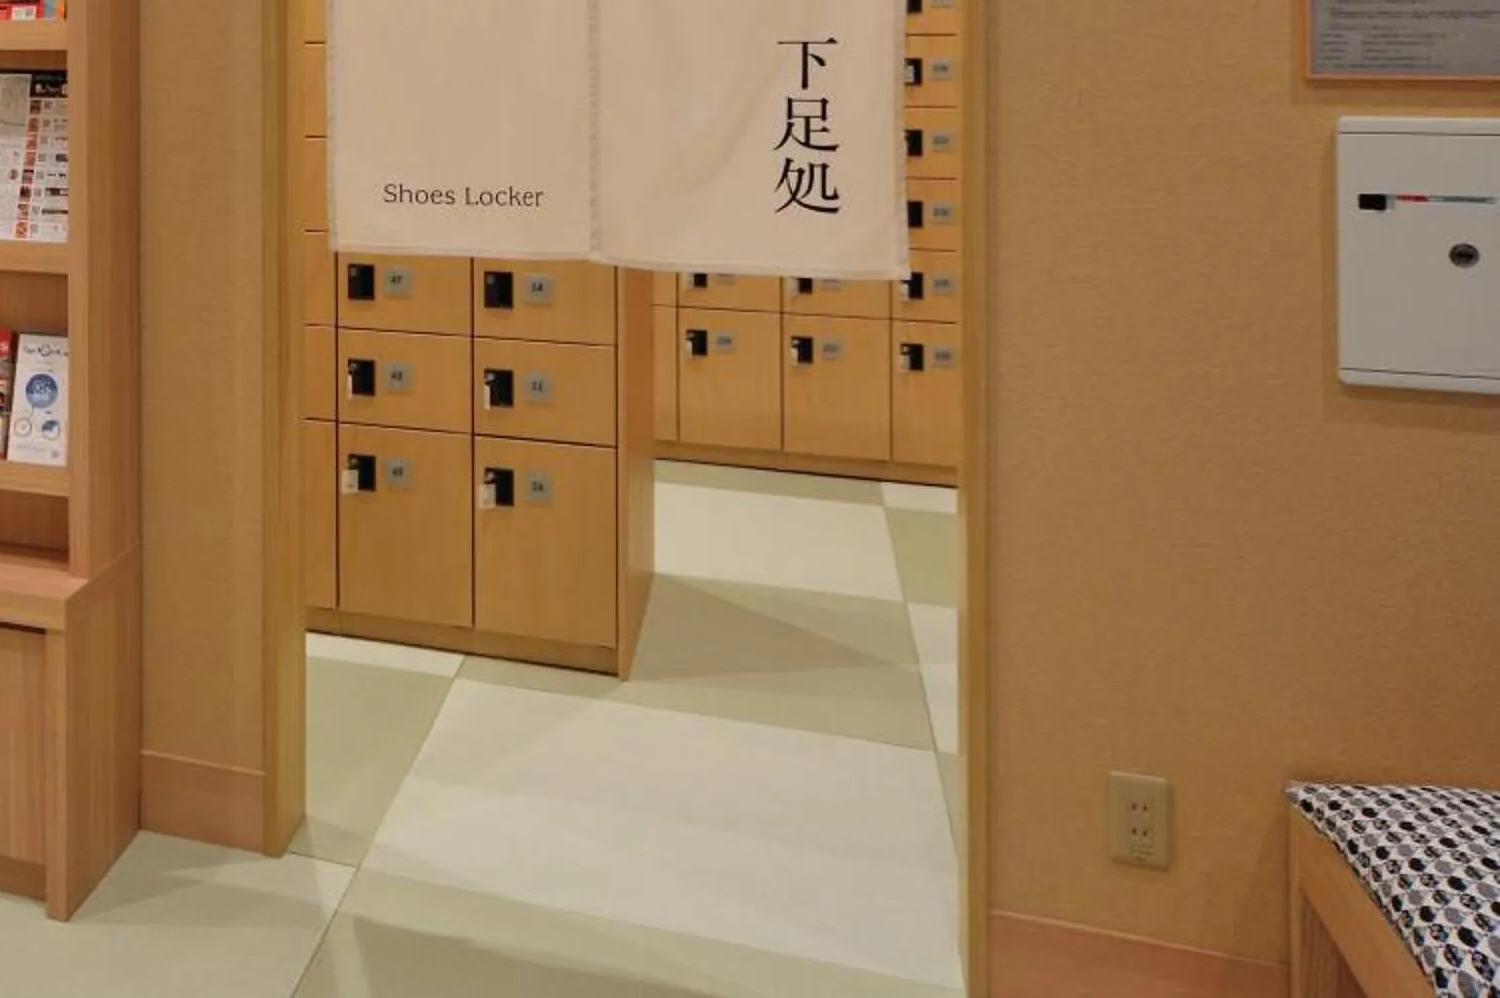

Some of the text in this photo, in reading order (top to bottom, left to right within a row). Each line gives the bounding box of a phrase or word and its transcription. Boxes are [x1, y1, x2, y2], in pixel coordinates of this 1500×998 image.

[772, 36, 841, 215] 下足処
[382, 183, 544, 208] Shoes Locker
